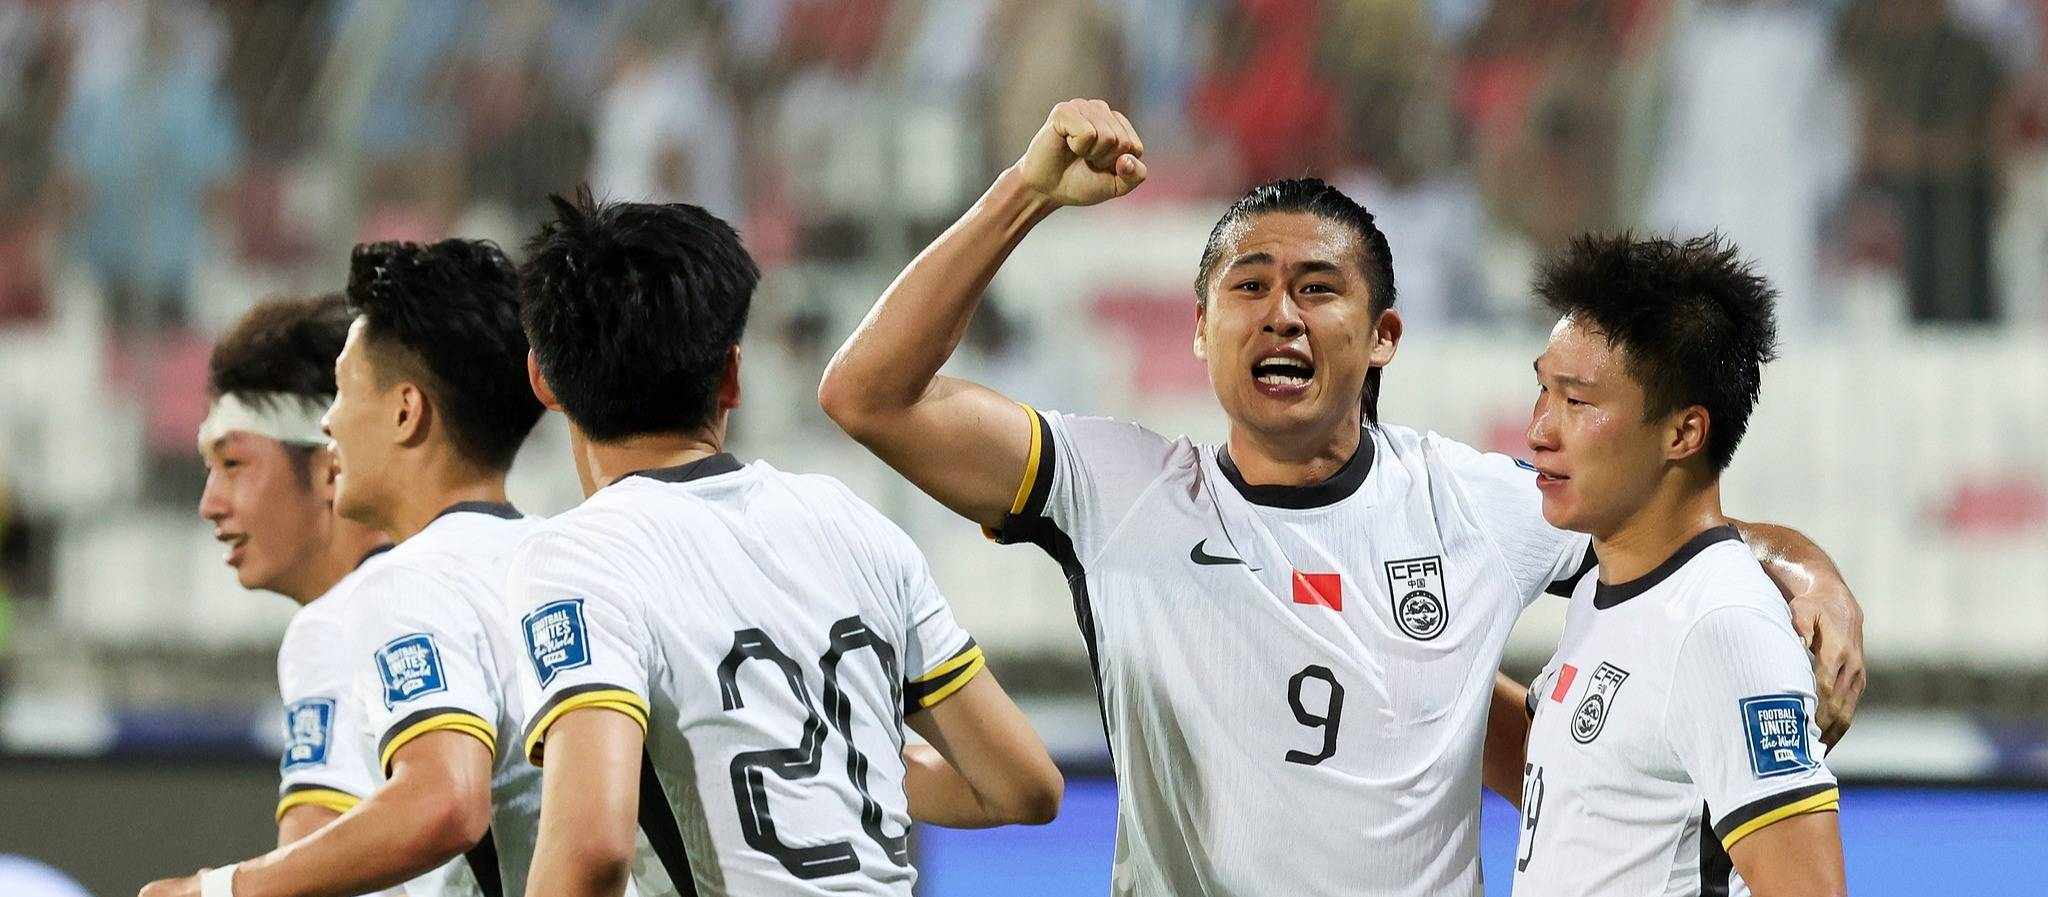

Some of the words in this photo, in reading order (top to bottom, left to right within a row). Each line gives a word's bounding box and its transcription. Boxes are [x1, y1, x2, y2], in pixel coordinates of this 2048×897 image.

[1392, 562, 1437, 580] CFA
[1595, 667, 1623, 688] CFA
[1285, 664, 1345, 766] 9
[1758, 708, 1797, 720] FOOTBALL
[1760, 720, 1798, 736] UNITES
[717, 615, 908, 879] 20
[1760, 736, 1777, 750] the
[1777, 735, 1801, 749] World
